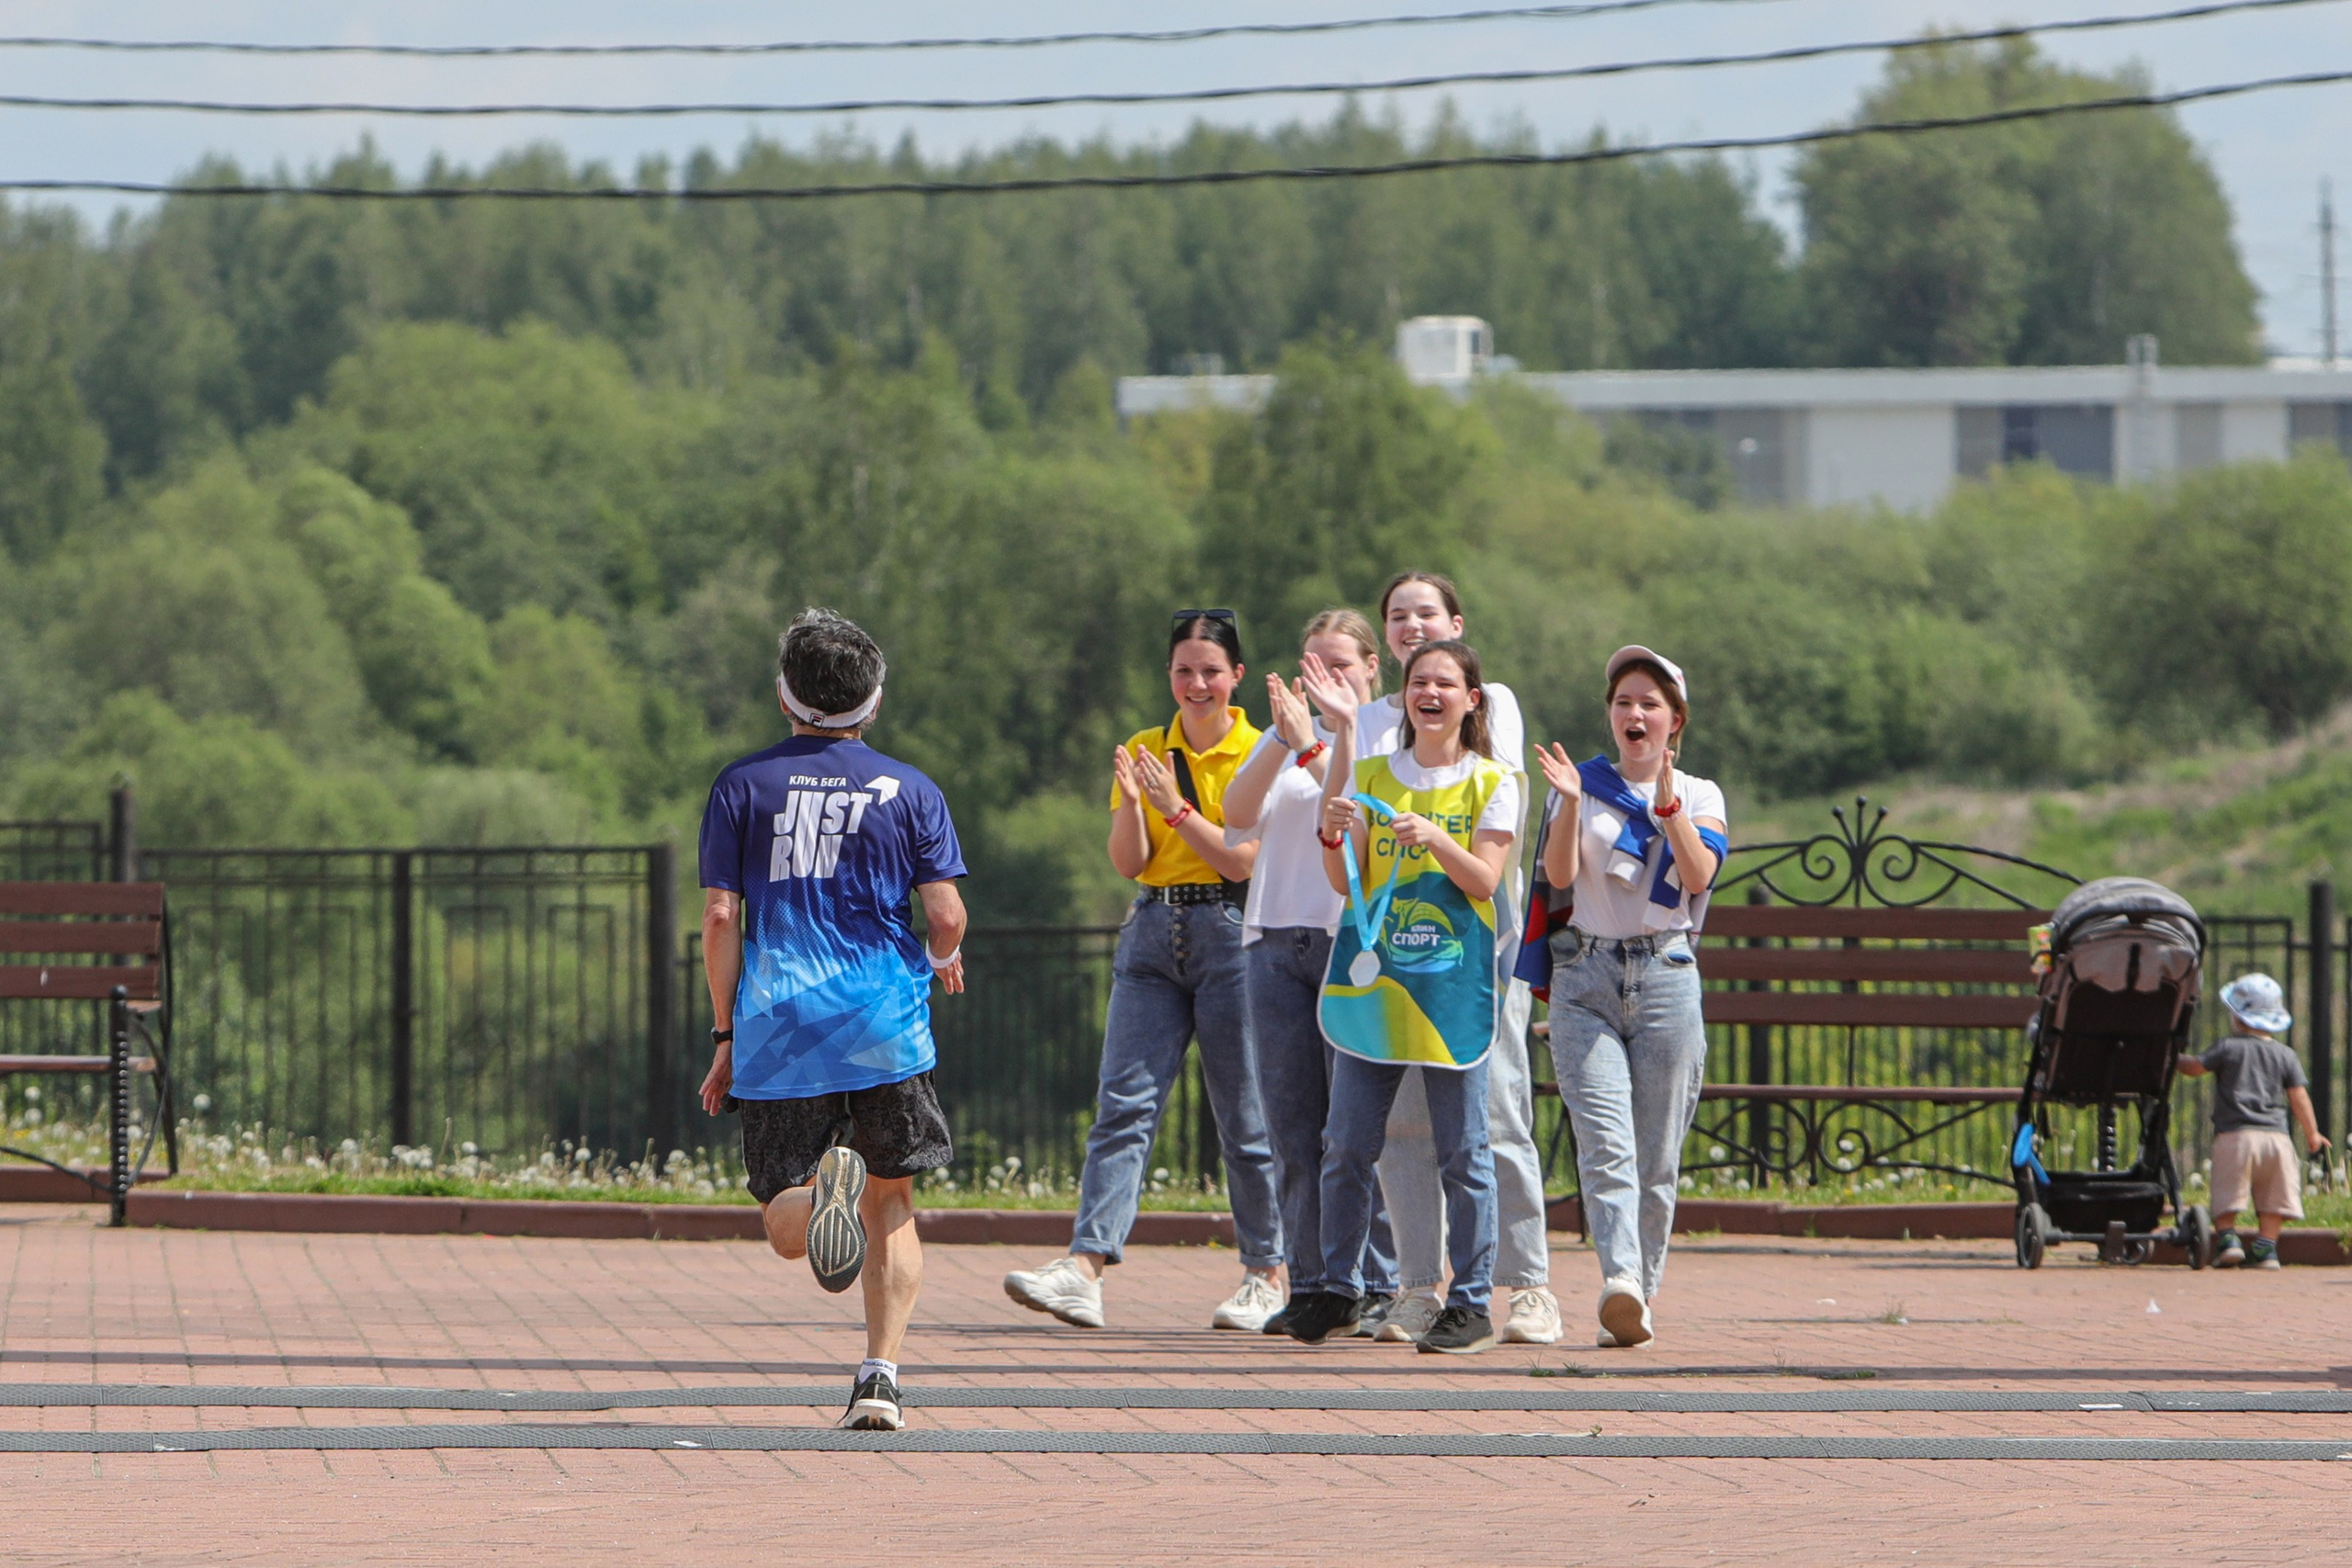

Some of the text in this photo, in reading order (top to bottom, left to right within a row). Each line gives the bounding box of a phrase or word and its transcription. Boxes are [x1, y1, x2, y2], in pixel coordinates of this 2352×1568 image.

[789, 775, 846, 787] КЛУБ БЕГА
[773, 790, 873, 835] JUST
[769, 834, 844, 883] RUN
[1392, 932, 1441, 947] СПОРТ
